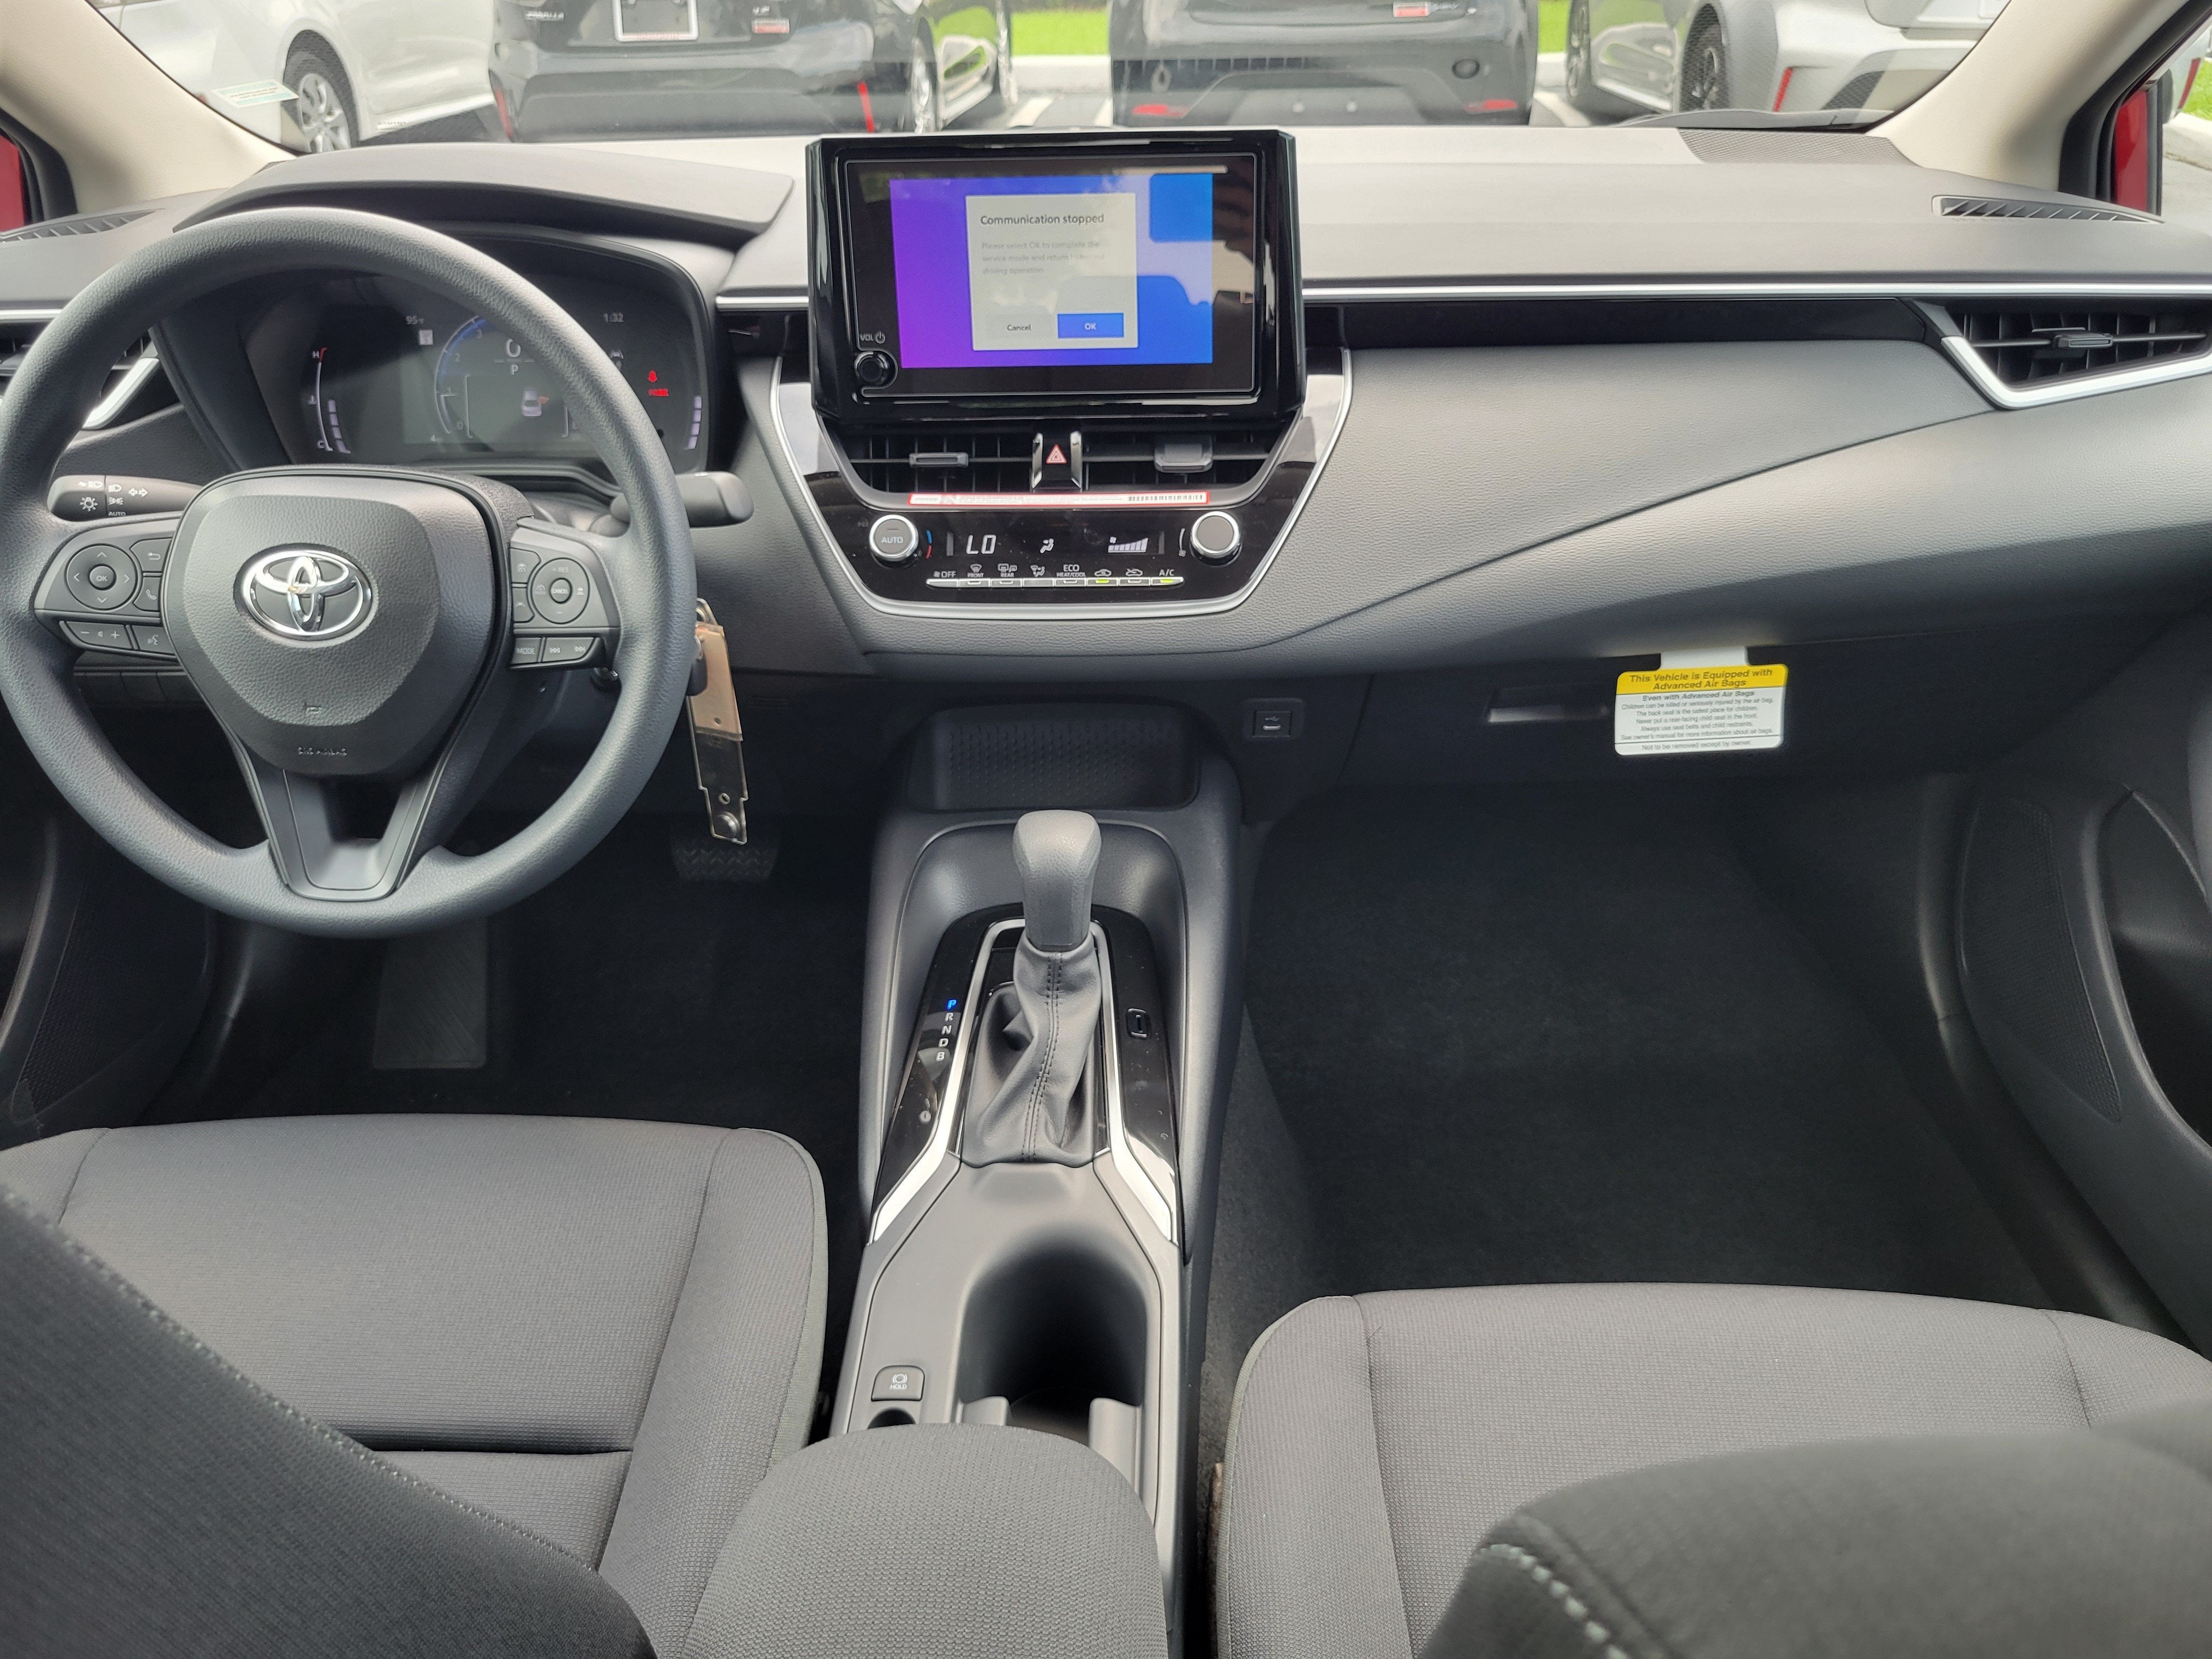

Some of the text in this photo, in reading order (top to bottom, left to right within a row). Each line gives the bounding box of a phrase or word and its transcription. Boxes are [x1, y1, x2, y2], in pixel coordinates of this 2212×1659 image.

[980, 214, 1104, 225] Communication stopped
[1084, 323, 1097, 331] OK
[859, 333, 874, 341] VOL
[511, 364, 518, 375] P
[966, 534, 996, 554] LO
[1063, 564, 1080, 572] ECO
[1654, 673, 1688, 681] Vehicle
[1703, 670, 1750, 680] Equipped
[1653, 681, 1702, 690] Advanced
[946, 999, 957, 1010] P
[945, 1012, 953, 1022] R
[941, 1025, 952, 1035] N
[938, 1037, 949, 1047] D
[935, 1051, 945, 1062] B
